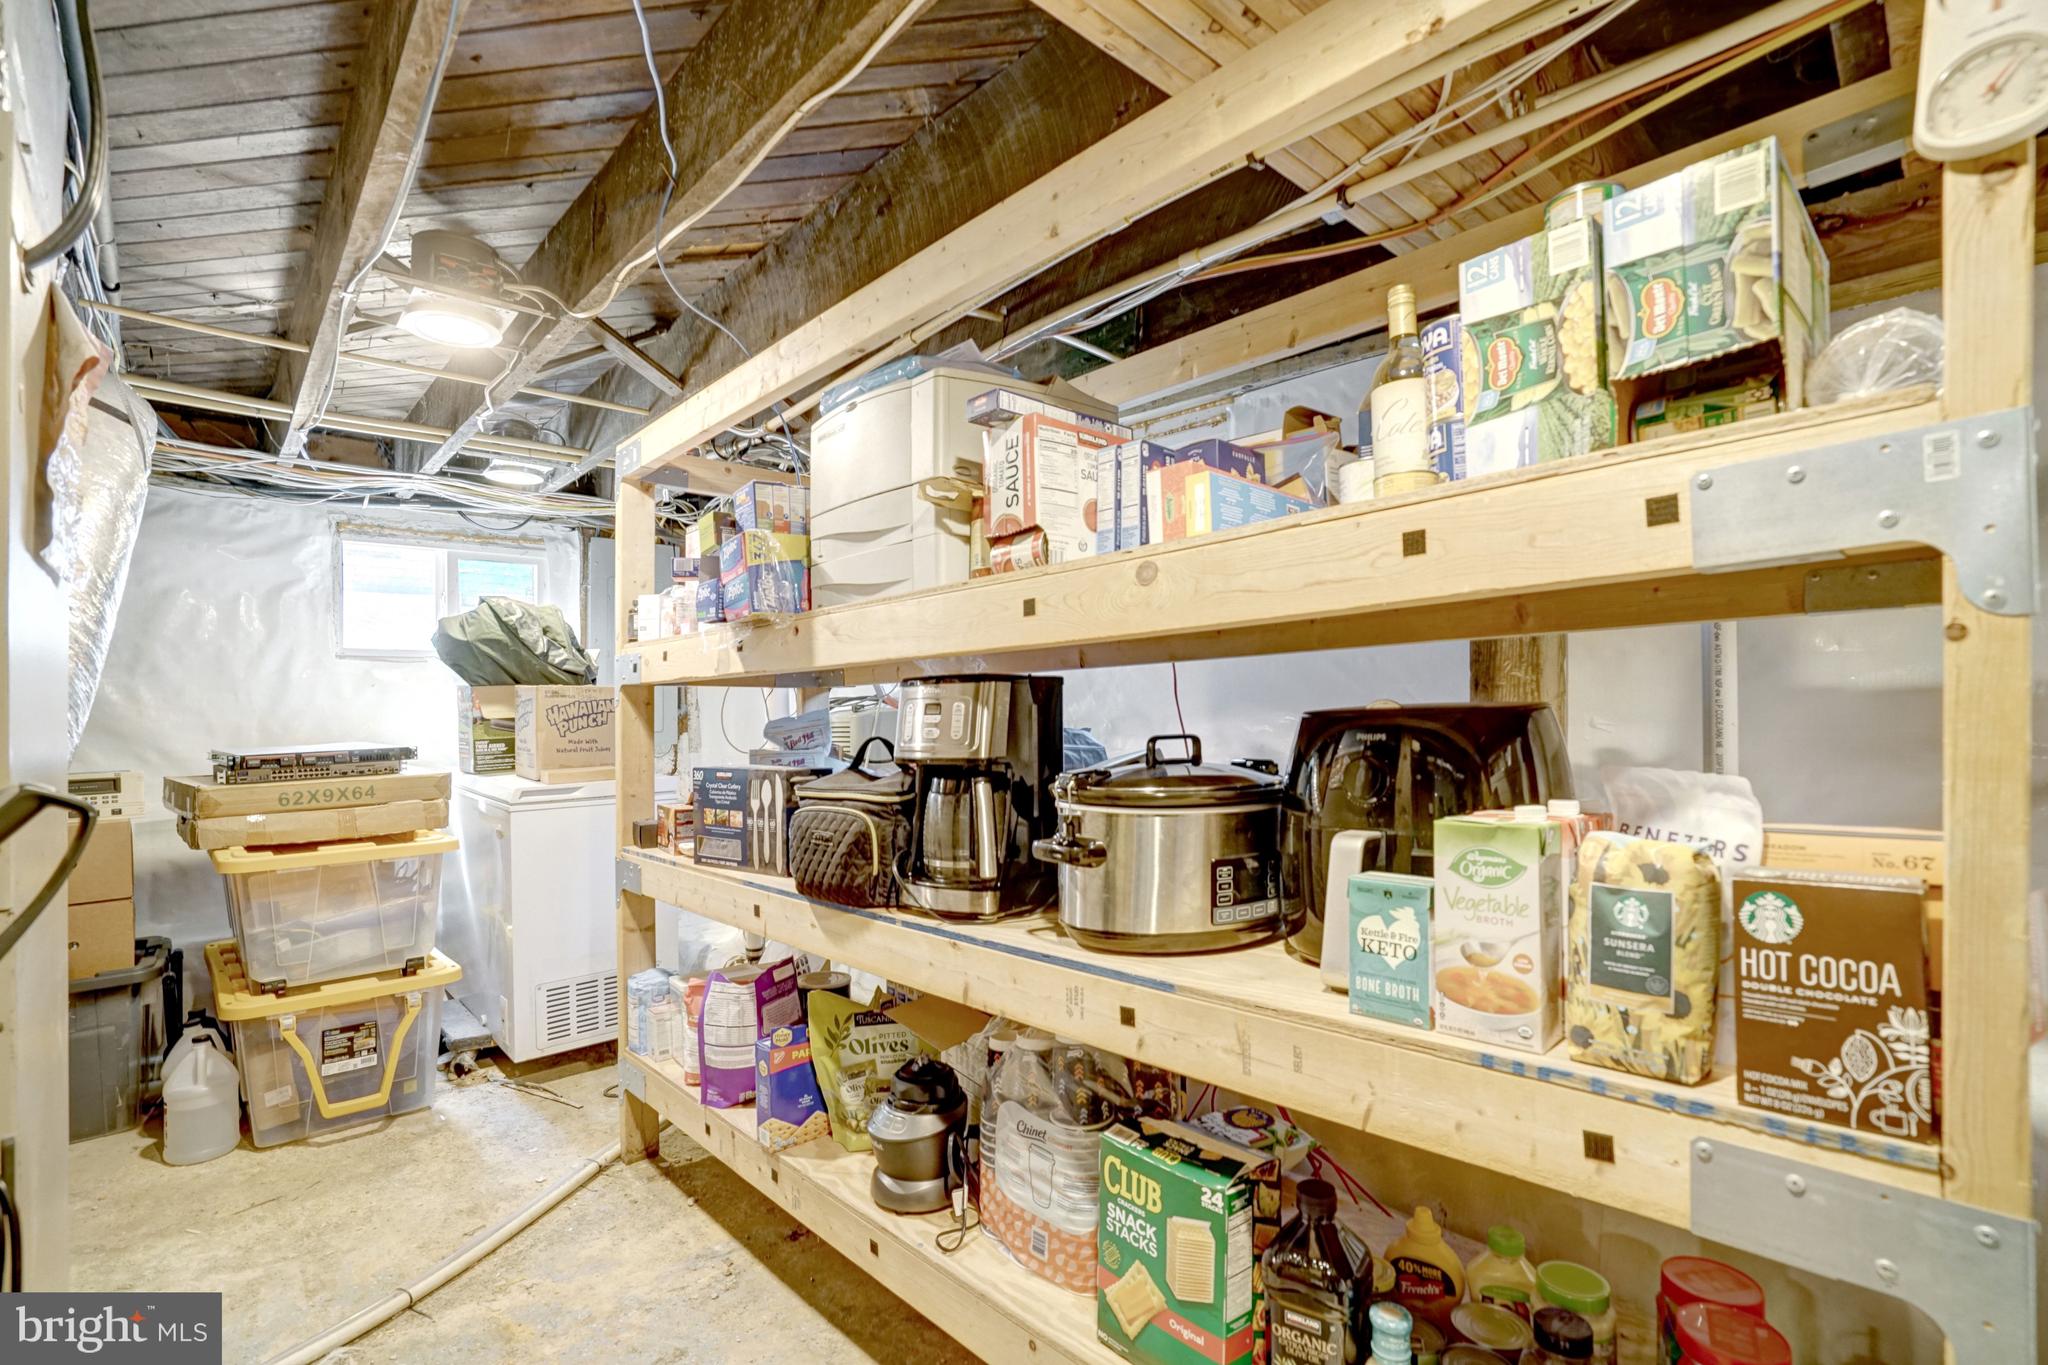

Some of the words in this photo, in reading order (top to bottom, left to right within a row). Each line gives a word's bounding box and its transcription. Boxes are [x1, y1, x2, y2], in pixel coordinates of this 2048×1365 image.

[1467, 259, 1489, 289] 12
[1422, 326, 1449, 353] YA
[1006, 434, 1019, 509] SAUCE
[1081, 469, 1099, 482] SAU
[546, 698, 615, 727] HAWAIIAN
[557, 711, 609, 737] PUNCH
[1356, 732, 1386, 742] PHILIPS
[693, 770, 704, 780] 360
[278, 785, 376, 807] 62X9X64
[1903, 855, 1937, 871] 67
[1443, 886, 1530, 922] Vegetable
[1475, 915, 1514, 927] BROTH
[1361, 927, 1389, 939] Kettle
[1398, 932, 1418, 943] Fire
[1603, 937, 1655, 953] SUNSERA
[1361, 937, 1418, 962] KETO
[1740, 946, 1792, 982] HOT
[1800, 953, 1902, 998] COCOA
[1355, 975, 1381, 994] BONE
[1385, 982, 1420, 1003] BROTH
[1741, 980, 1793, 995] DOUBLE
[1795, 987, 1878, 1007] CHOCOLATE
[849, 1037, 909, 1056] Olives
[878, 1031, 907, 1040] PITTED
[1016, 1119, 1048, 1140] Chinet
[1104, 1155, 1163, 1214] CLUB
[1117, 1198, 1146, 1217] CRACKERS
[1200, 1187, 1224, 1206] 24
[1107, 1202, 1157, 1242] SNACK
[1106, 1217, 1158, 1258] STACKS
[1398, 1259, 1421, 1275] 40%
[1421, 1265, 1443, 1281] MORE
[1400, 1280, 1440, 1295] French's
[1168, 1318, 1205, 1347] Original
[1272, 1323, 1337, 1355] ORGANIC
